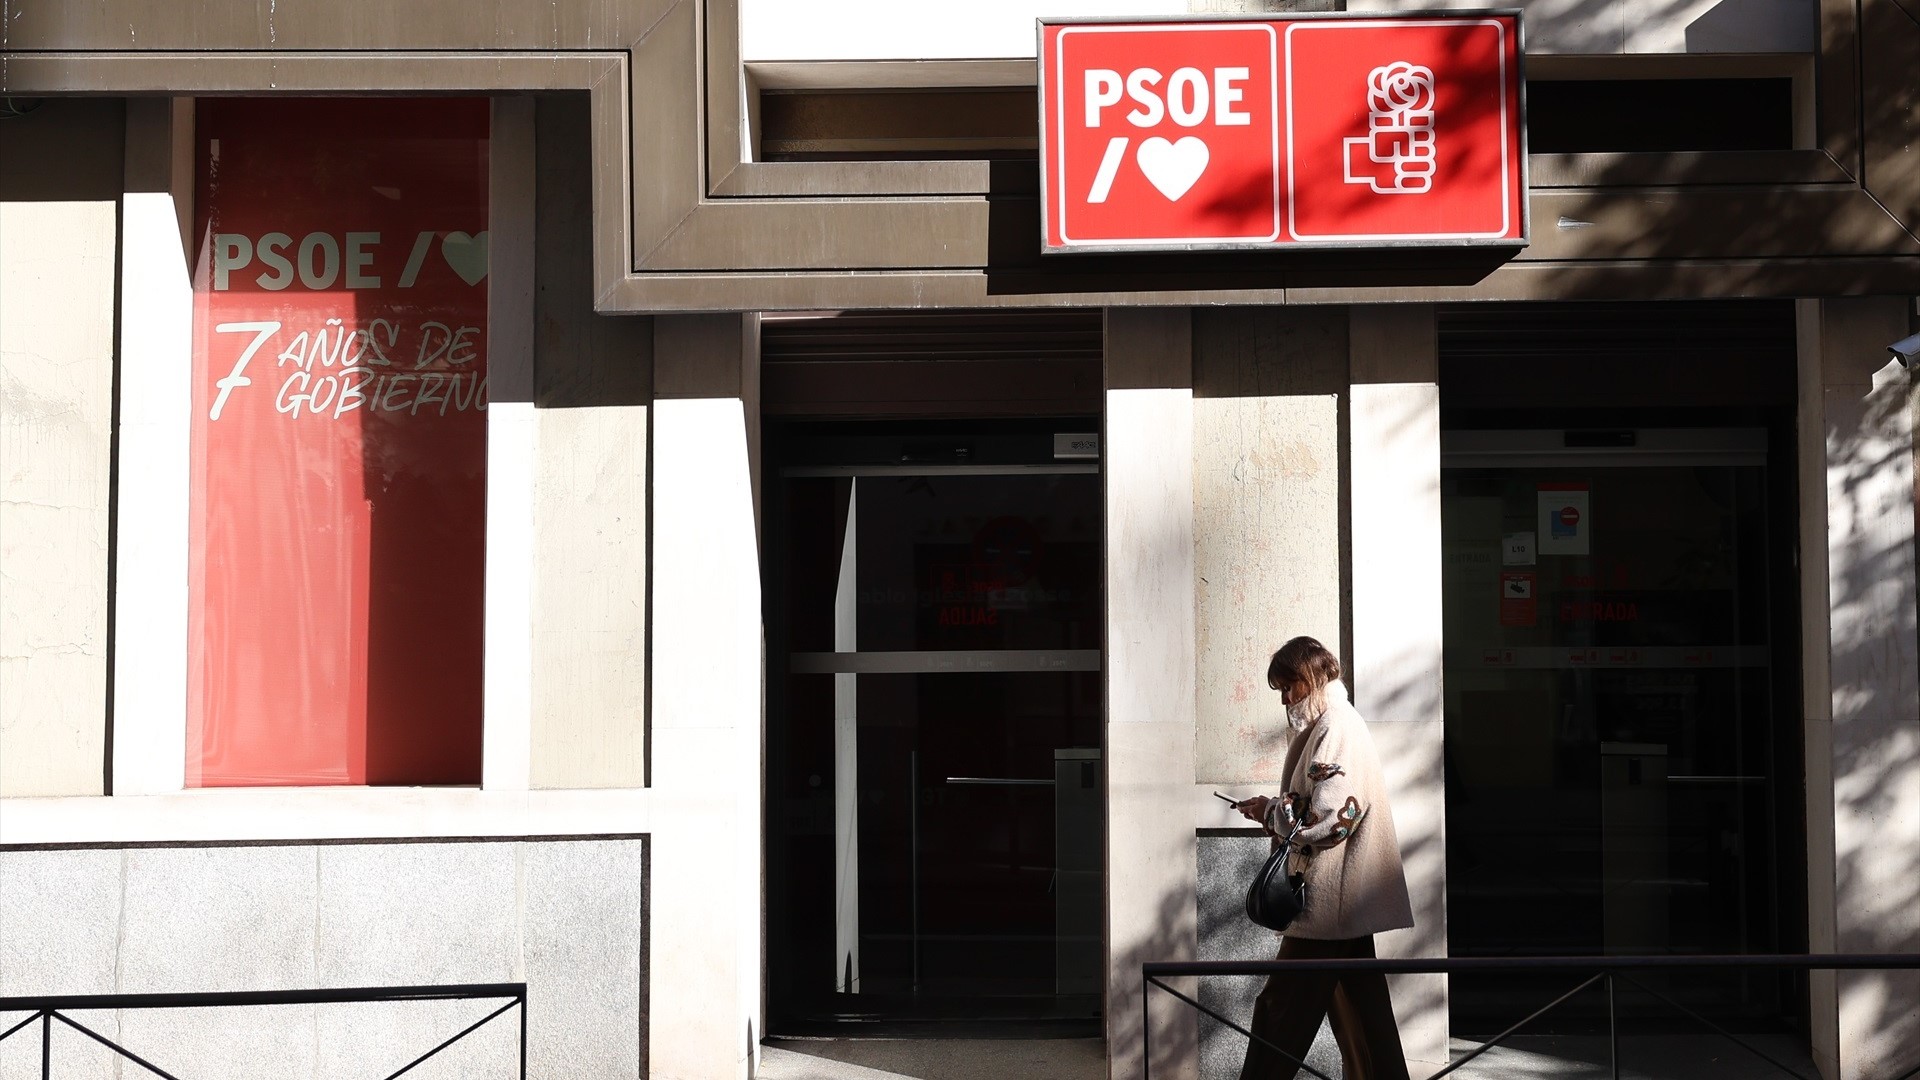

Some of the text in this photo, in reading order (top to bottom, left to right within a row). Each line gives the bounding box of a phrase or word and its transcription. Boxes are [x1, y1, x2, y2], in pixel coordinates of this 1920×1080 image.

[1085, 67, 1251, 128] PSOE
[214, 231, 381, 291] PSOE
[210, 318, 482, 420] 7 AÑOS DE
